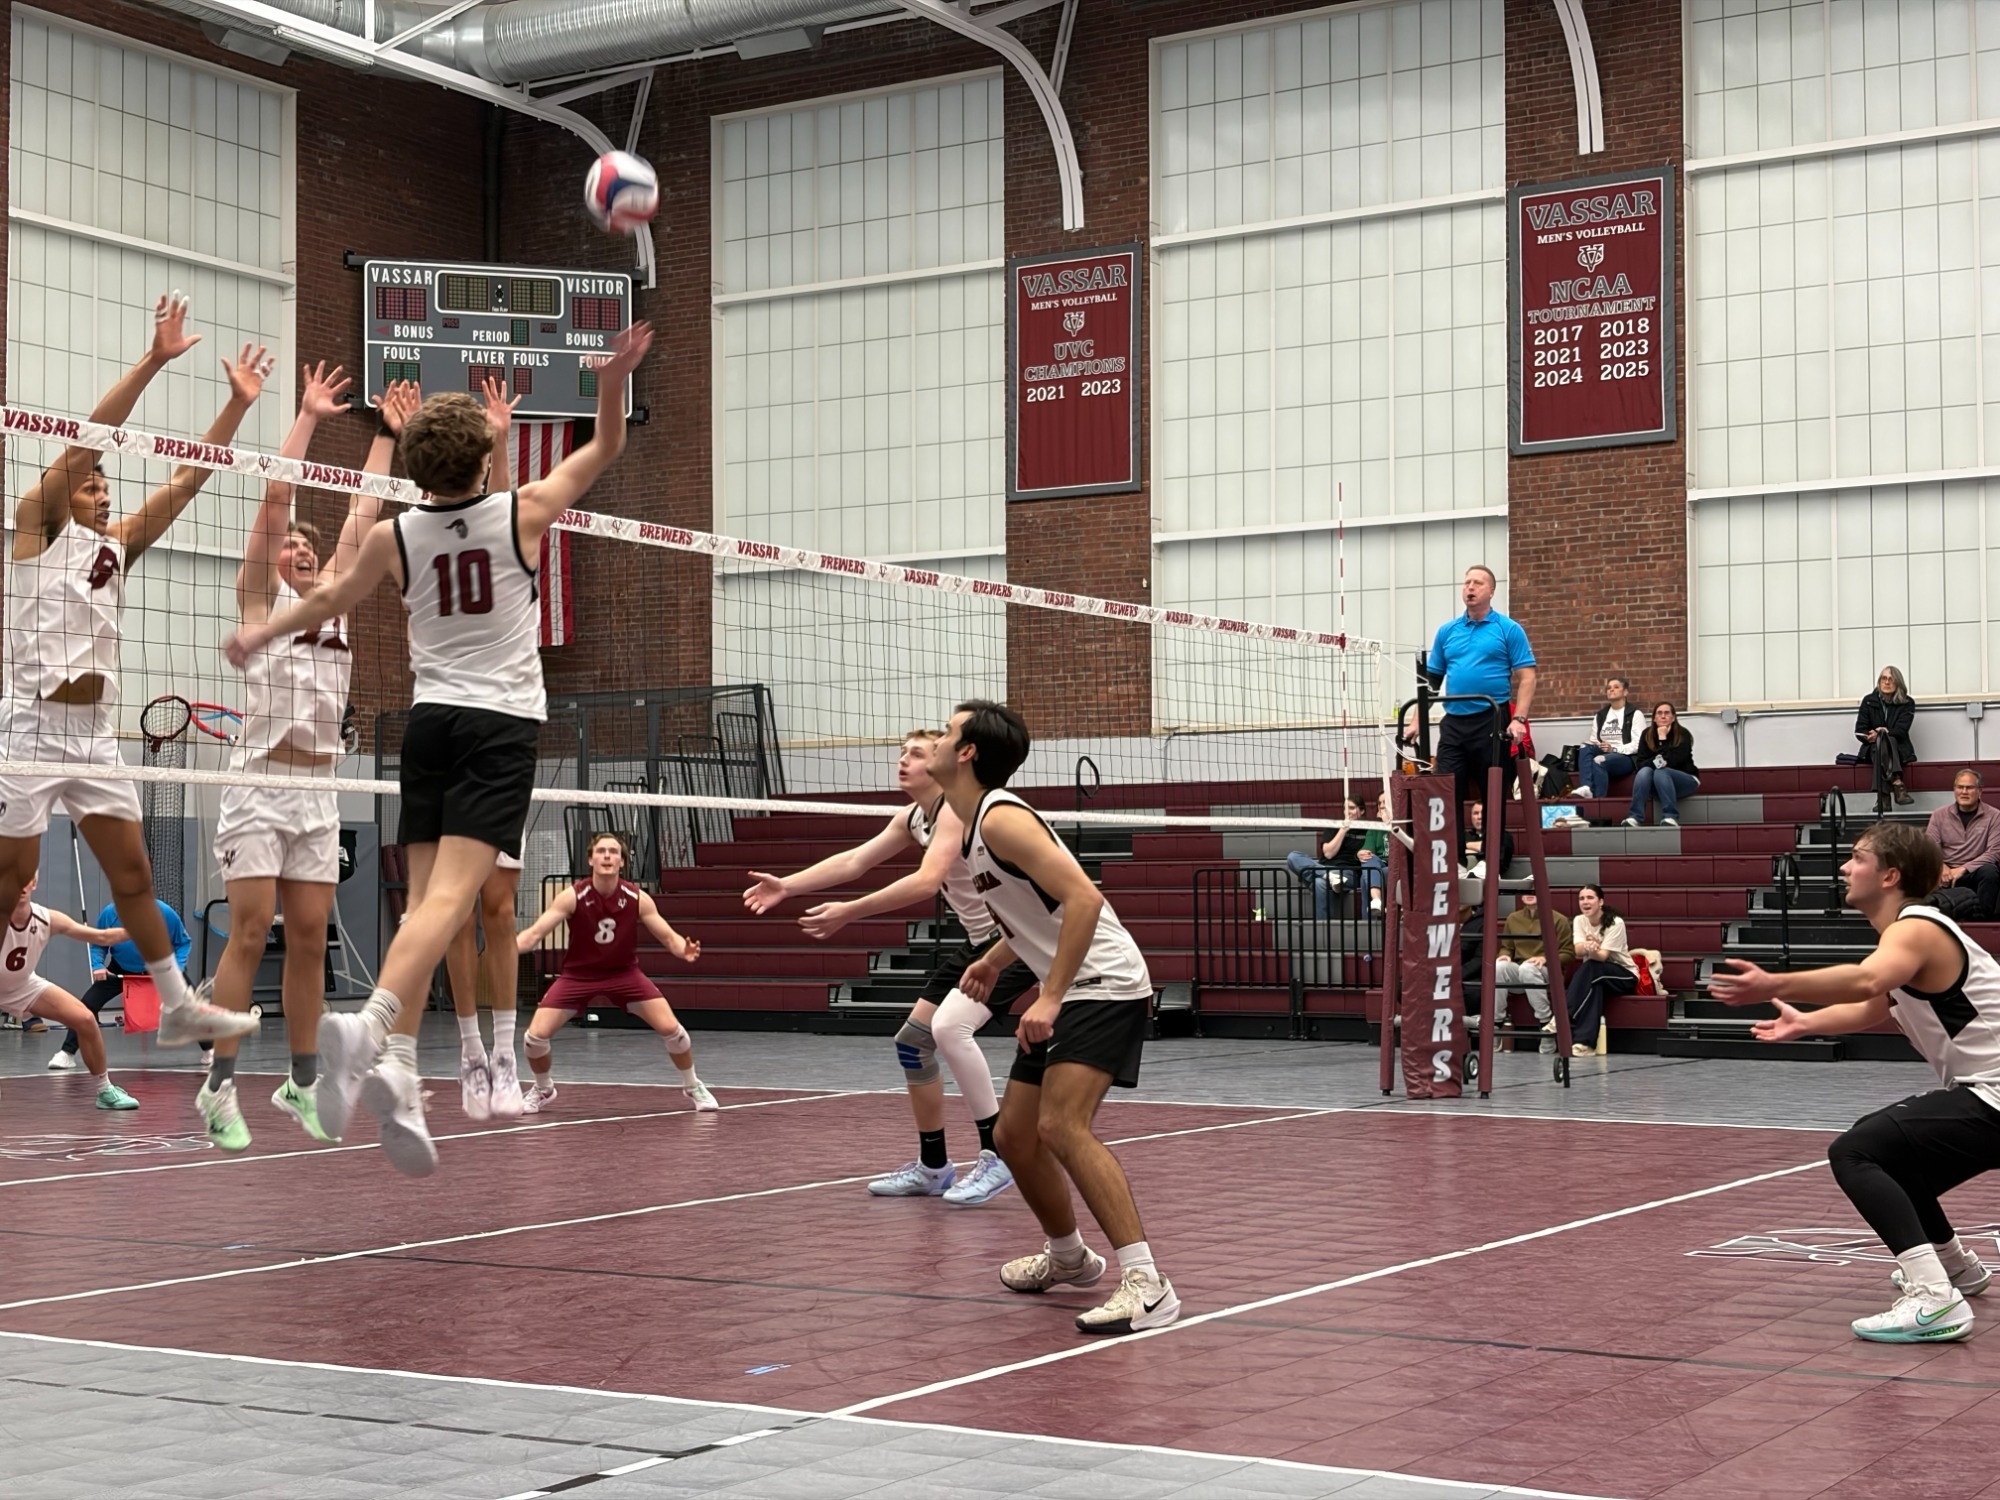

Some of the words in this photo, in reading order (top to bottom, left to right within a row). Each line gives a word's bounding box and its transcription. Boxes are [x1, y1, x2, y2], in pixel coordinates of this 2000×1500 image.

[1526, 190, 1656, 231] VASSAR
[1537, 231, 1573, 244] MEN'S
[1575, 222, 1645, 240] VOLLEYBALL
[371, 267, 433, 285] VASSAR
[566, 278, 624, 296] VISITOR
[1022, 264, 1127, 298] VASSAR
[1549, 273, 1632, 304] NCAA
[1031, 299, 1059, 311] MEN'S
[1062, 293, 1117, 307] VOLLEYBALL
[1528, 296, 1655, 325] TOURNAMENT
[394, 324, 433, 340] BONUS
[472, 330, 510, 343] PERIOD
[566, 333, 604, 347] BONUS
[1534, 325, 1583, 345] 2017
[1600, 317, 1650, 338] 2018
[383, 346, 420, 361] FOULS
[461, 350, 505, 365] PLAYER
[513, 353, 549, 367] FOULS
[1054, 340, 1094, 360] UVC
[1534, 347, 1582, 367] 2021
[1600, 339, 1649, 359] 2023
[1024, 357, 1125, 382] CHAMPIONS
[1534, 367, 1583, 388] 2024
[1600, 360, 1649, 381] 2025
[1027, 385, 1065, 402] 2021
[1081, 379, 1121, 396] 2023
[3, 408, 80, 440] VASSAR
[153, 436, 234, 466] BREWERS
[301, 463, 363, 489] VASSAR
[640, 523, 693, 546] BREWERS
[737, 540, 780, 560] VASSAR
[820, 555, 866, 575] BREWERS
[903, 568, 939, 587] VASSAR
[972, 580, 1013, 598] BREWERS
[1044, 591, 1076, 608] VASSAR
[1104, 601, 1138, 617] BREWERS
[1272, 626, 1297, 640] VASSAR
[432, 548, 494, 617] 10
[594, 918, 616, 944] 8
[1426, 797, 1456, 1084] BREWERS
[5, 946, 27, 972] 6
